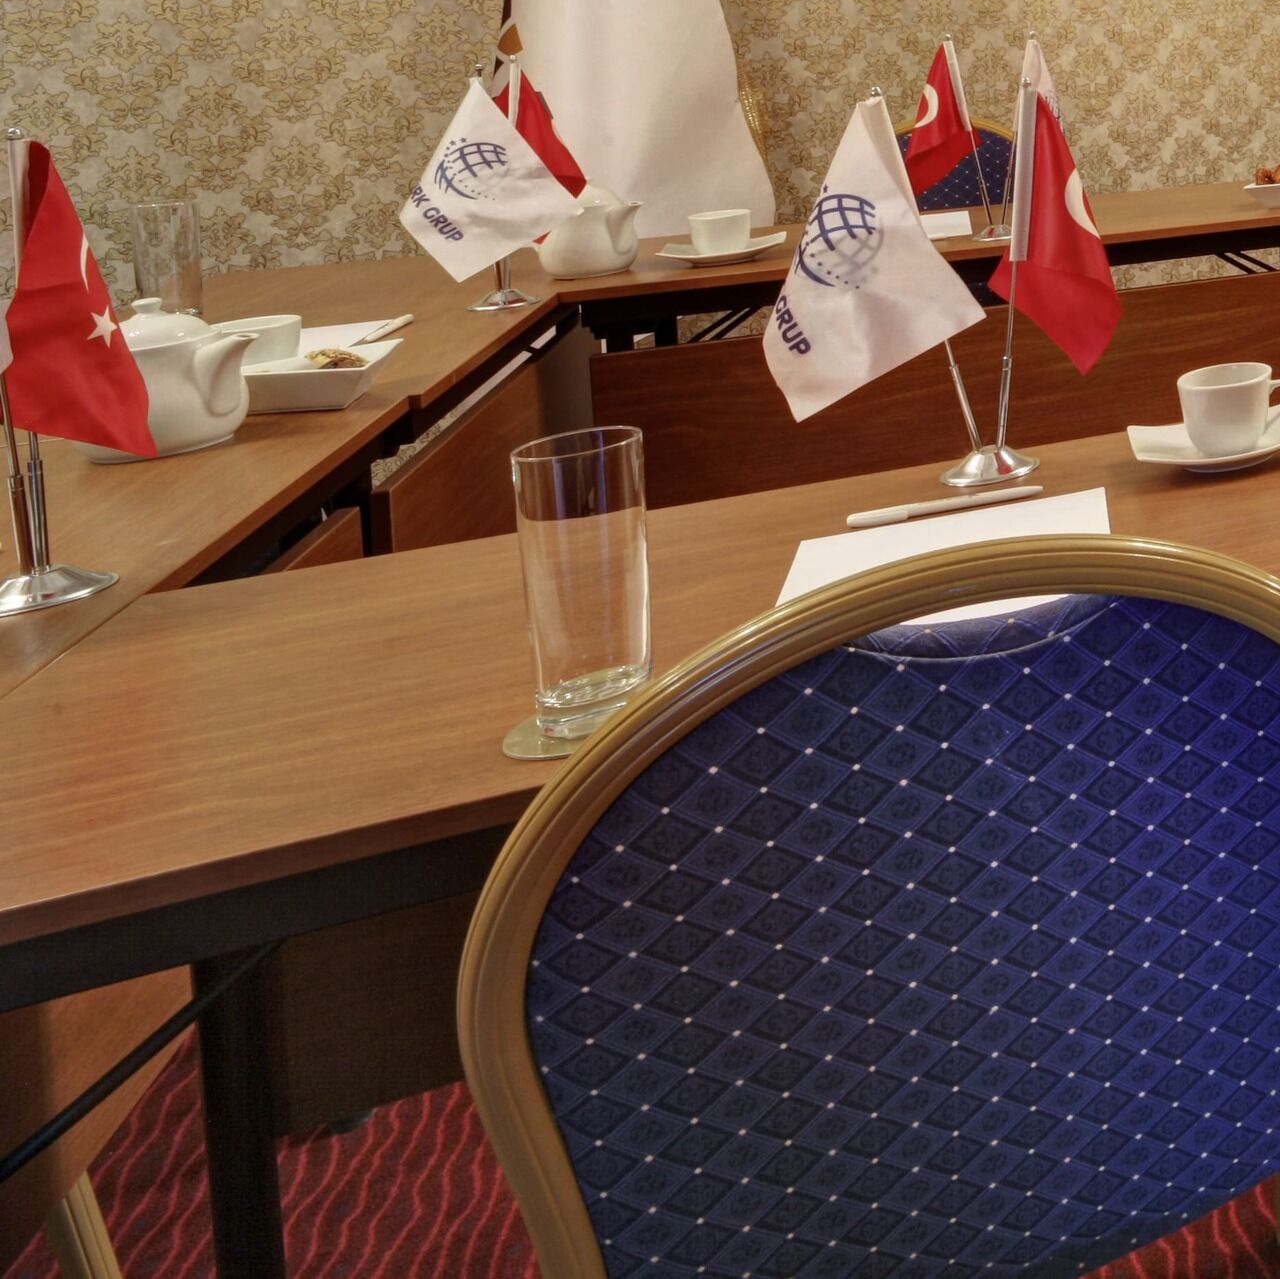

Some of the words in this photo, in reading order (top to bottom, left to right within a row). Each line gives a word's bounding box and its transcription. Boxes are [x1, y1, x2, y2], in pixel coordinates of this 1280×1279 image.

[410, 182, 430, 208] RK
[422, 207, 464, 241] GRUP
[775, 295, 811, 355] GRUP
